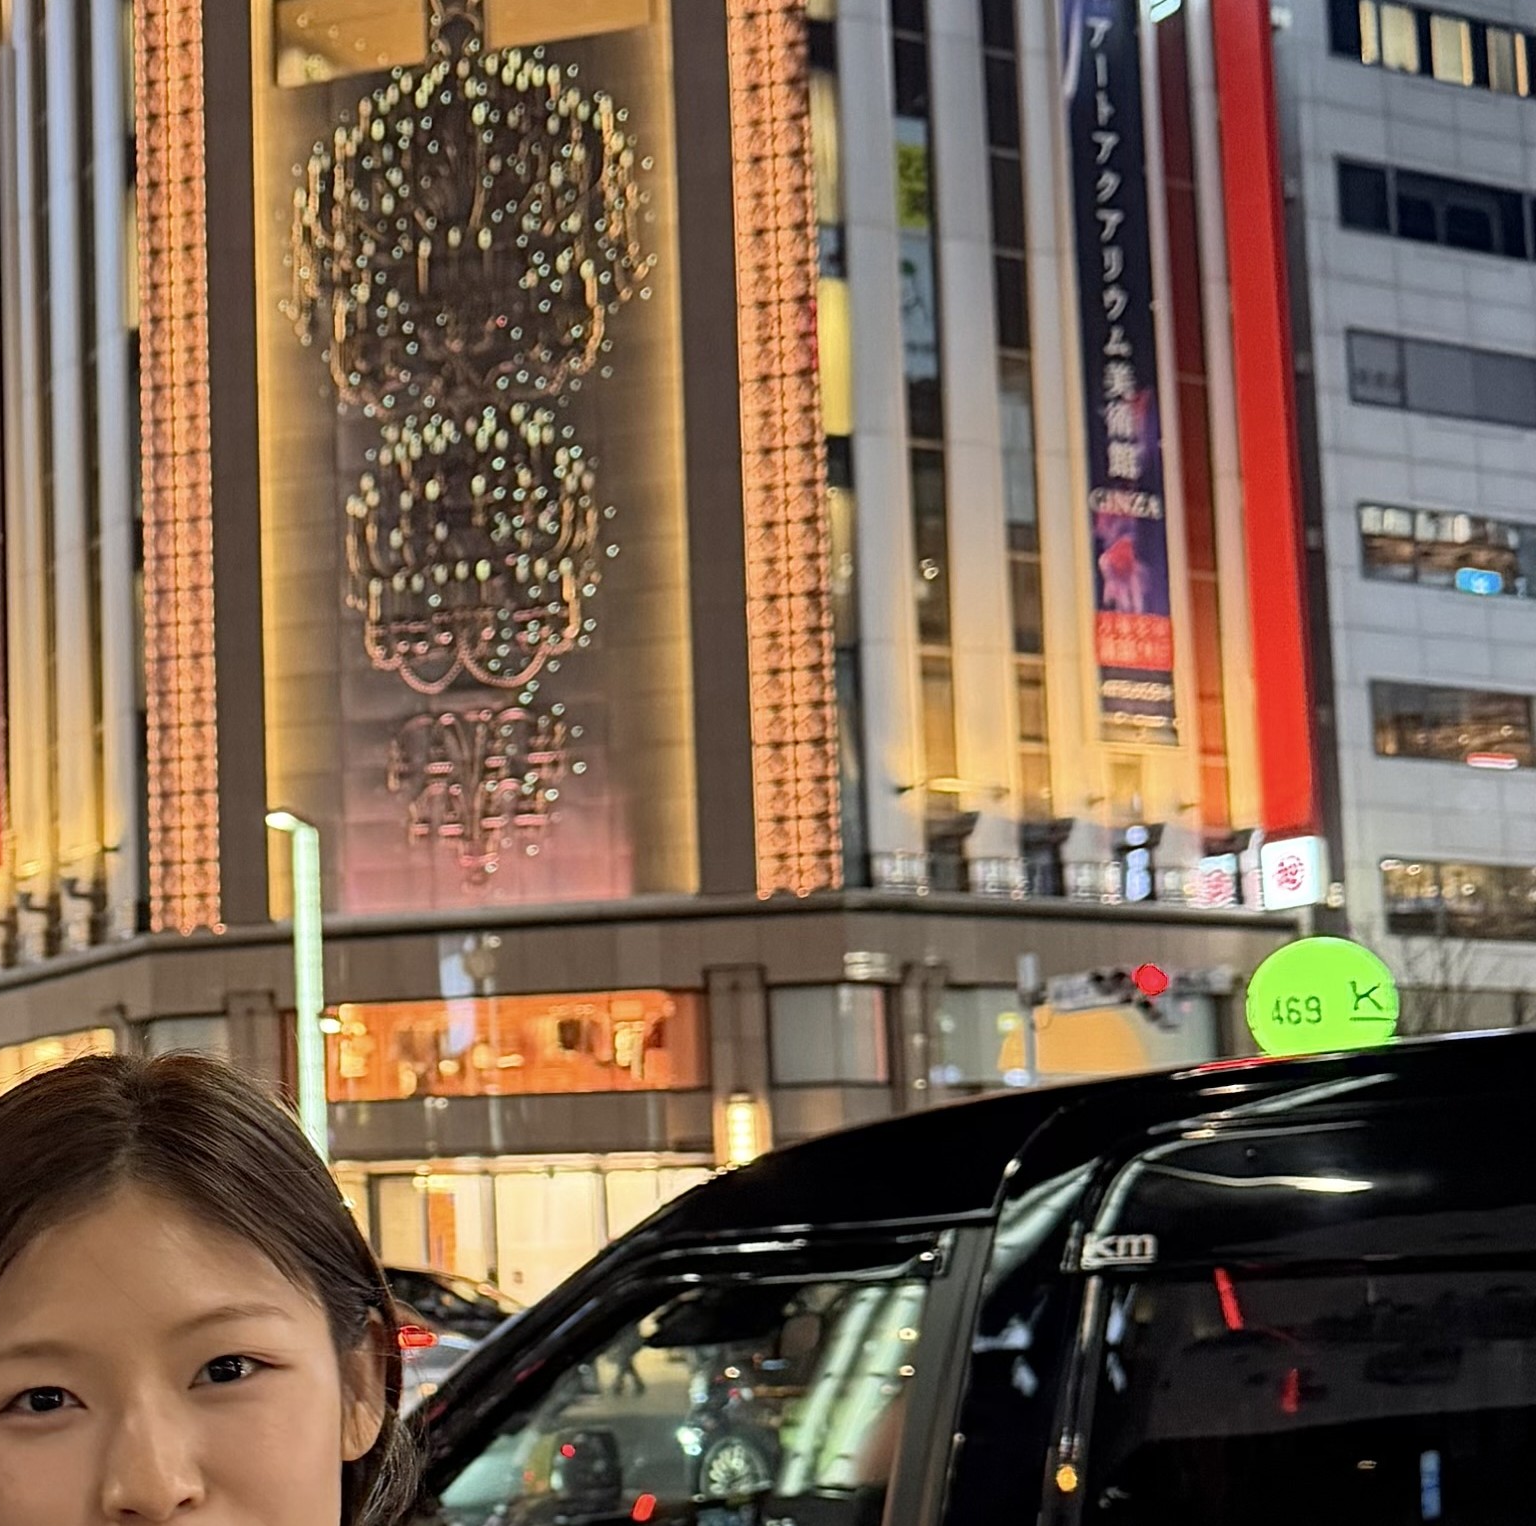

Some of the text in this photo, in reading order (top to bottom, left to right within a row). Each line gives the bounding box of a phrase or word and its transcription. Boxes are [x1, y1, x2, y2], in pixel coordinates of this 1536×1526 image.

[1089, 487, 1163, 520] GINZA
[1272, 995, 1323, 1025] 469
[1082, 1232, 1158, 1259] km
